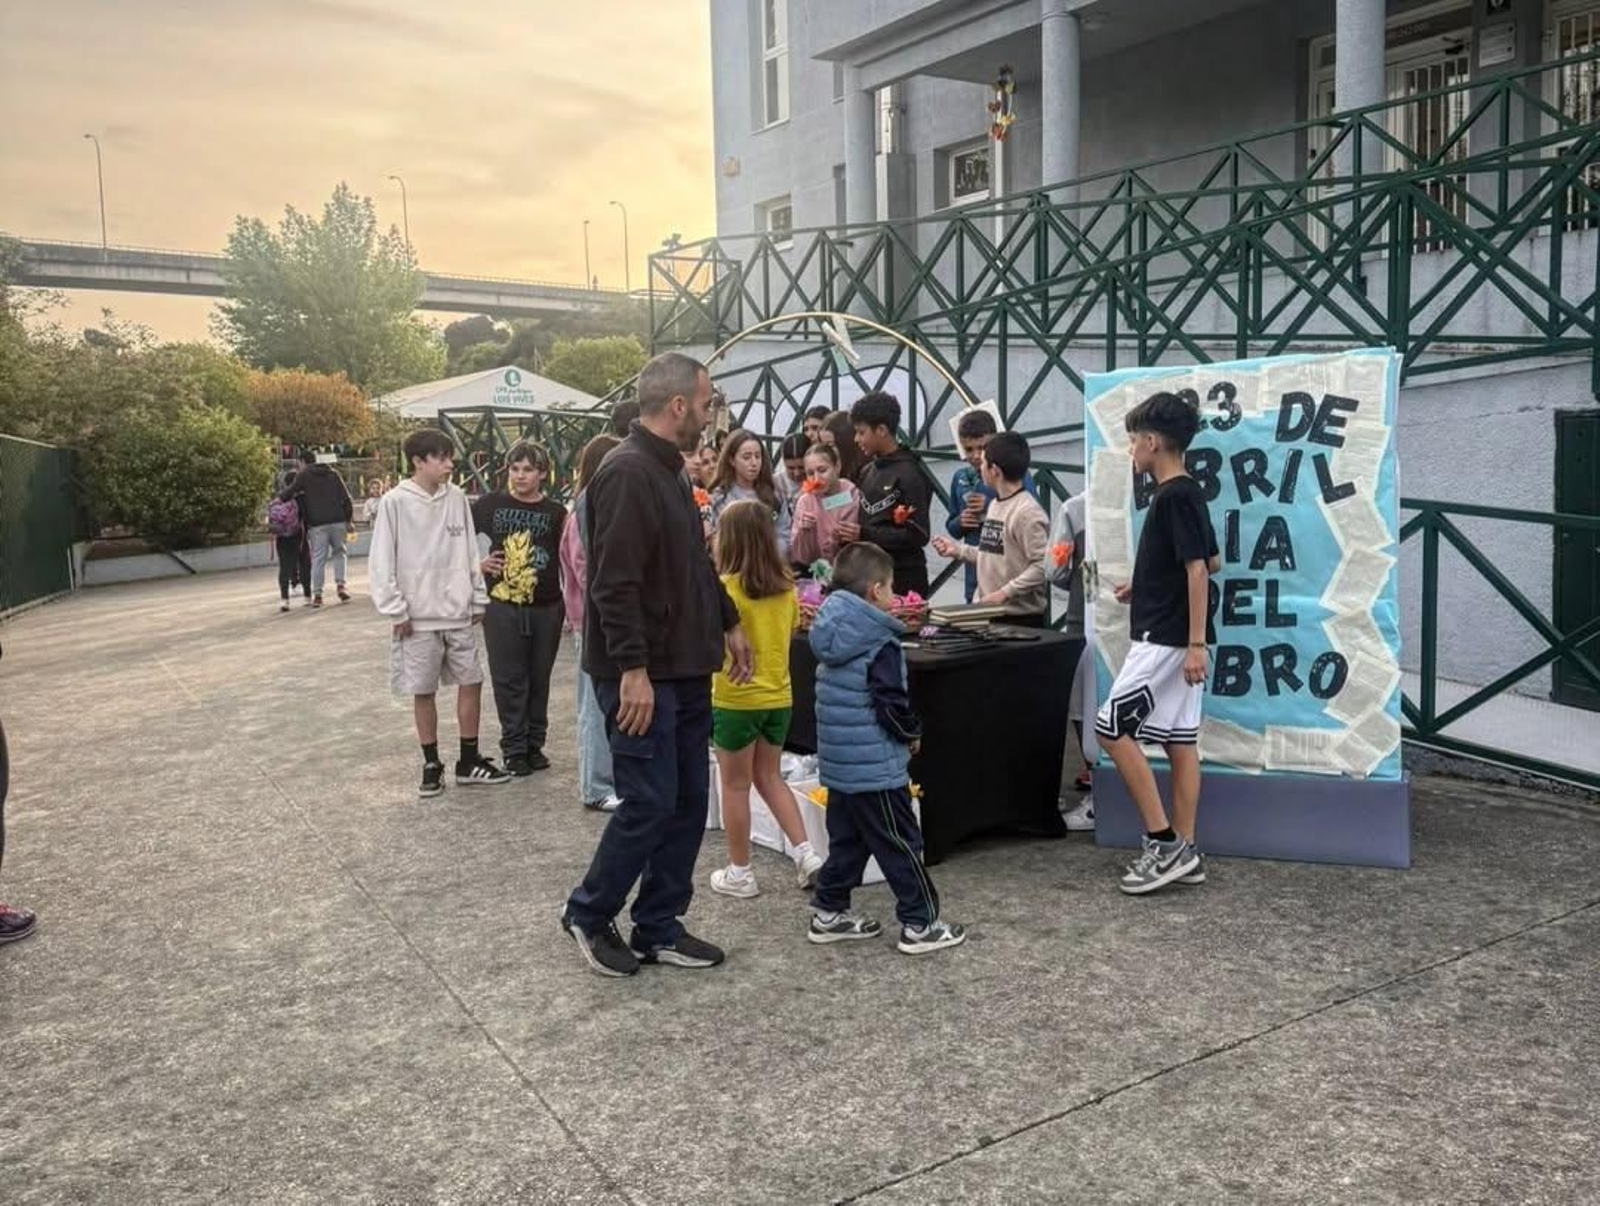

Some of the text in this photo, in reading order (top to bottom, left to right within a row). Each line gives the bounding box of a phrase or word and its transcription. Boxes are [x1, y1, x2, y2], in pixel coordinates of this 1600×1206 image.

[1274, 391, 1360, 448] DE
[1224, 509, 1296, 570] IA
[1203, 643, 1349, 700] BRO
